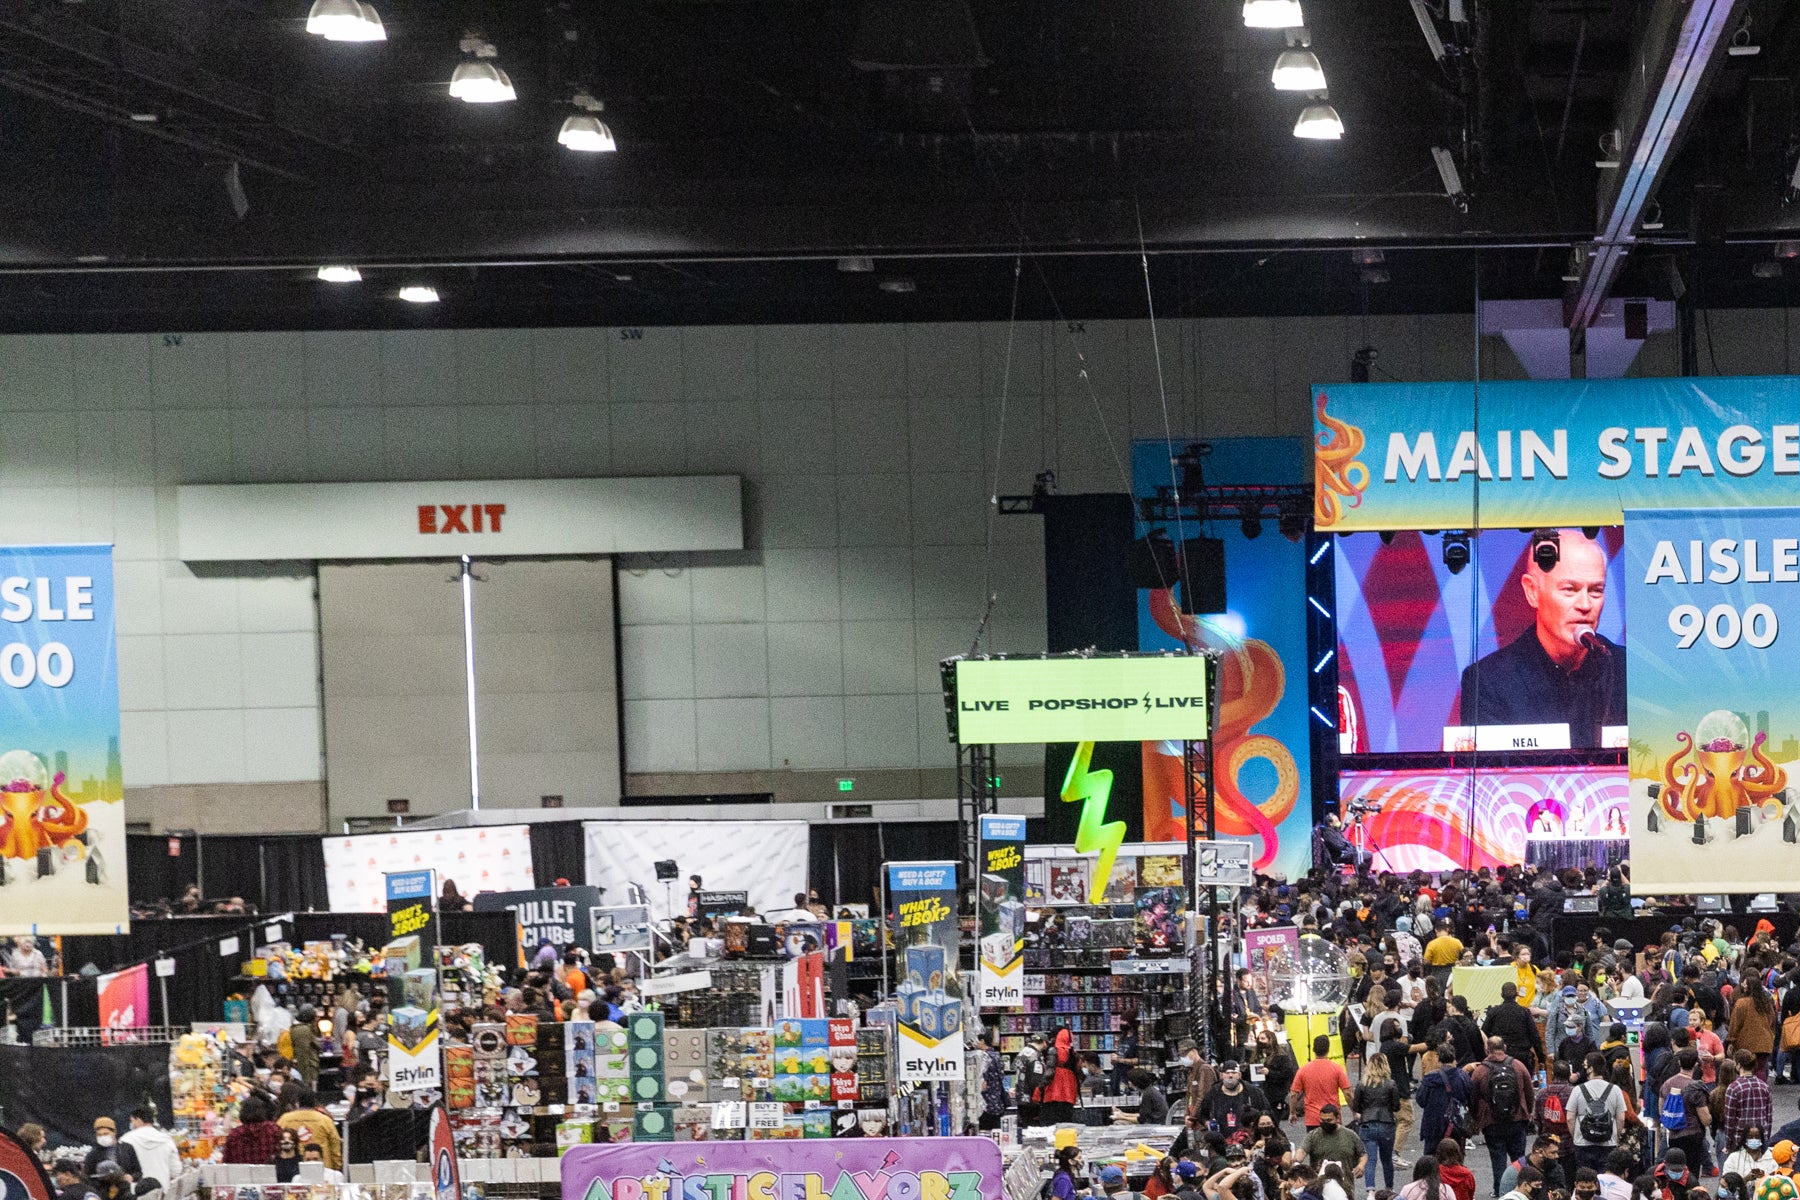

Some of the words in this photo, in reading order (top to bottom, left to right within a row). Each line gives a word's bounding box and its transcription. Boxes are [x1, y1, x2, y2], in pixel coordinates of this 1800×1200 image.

[1383, 430, 1568, 483] MAIN
[417, 503, 507, 535] EXIT
[1643, 537, 1800, 585] AISLE
[1667, 602, 1779, 649] 900
[961, 700, 1009, 711] LIVE
[1028, 697, 1138, 710] POPSHOP
[1155, 695, 1204, 708] LIVE
[1511, 736, 1540, 749] NEAL
[506, 900, 577, 926] ULLET
[899, 897, 941, 915] WHAT'S
[910, 906, 951, 926] BOX?
[1257, 934, 1290, 949] SPOILER
[985, 985, 1019, 1002] stylin
[830, 1023, 851, 1036] Tokyo
[834, 1031, 856, 1041] Ghoul
[395, 1065, 434, 1085] stylin
[906, 1057, 957, 1078] stylin
[831, 1077, 853, 1089] Tokyo
[836, 1085, 858, 1094] Ghoul
[754, 1119, 779, 1128] FREE
